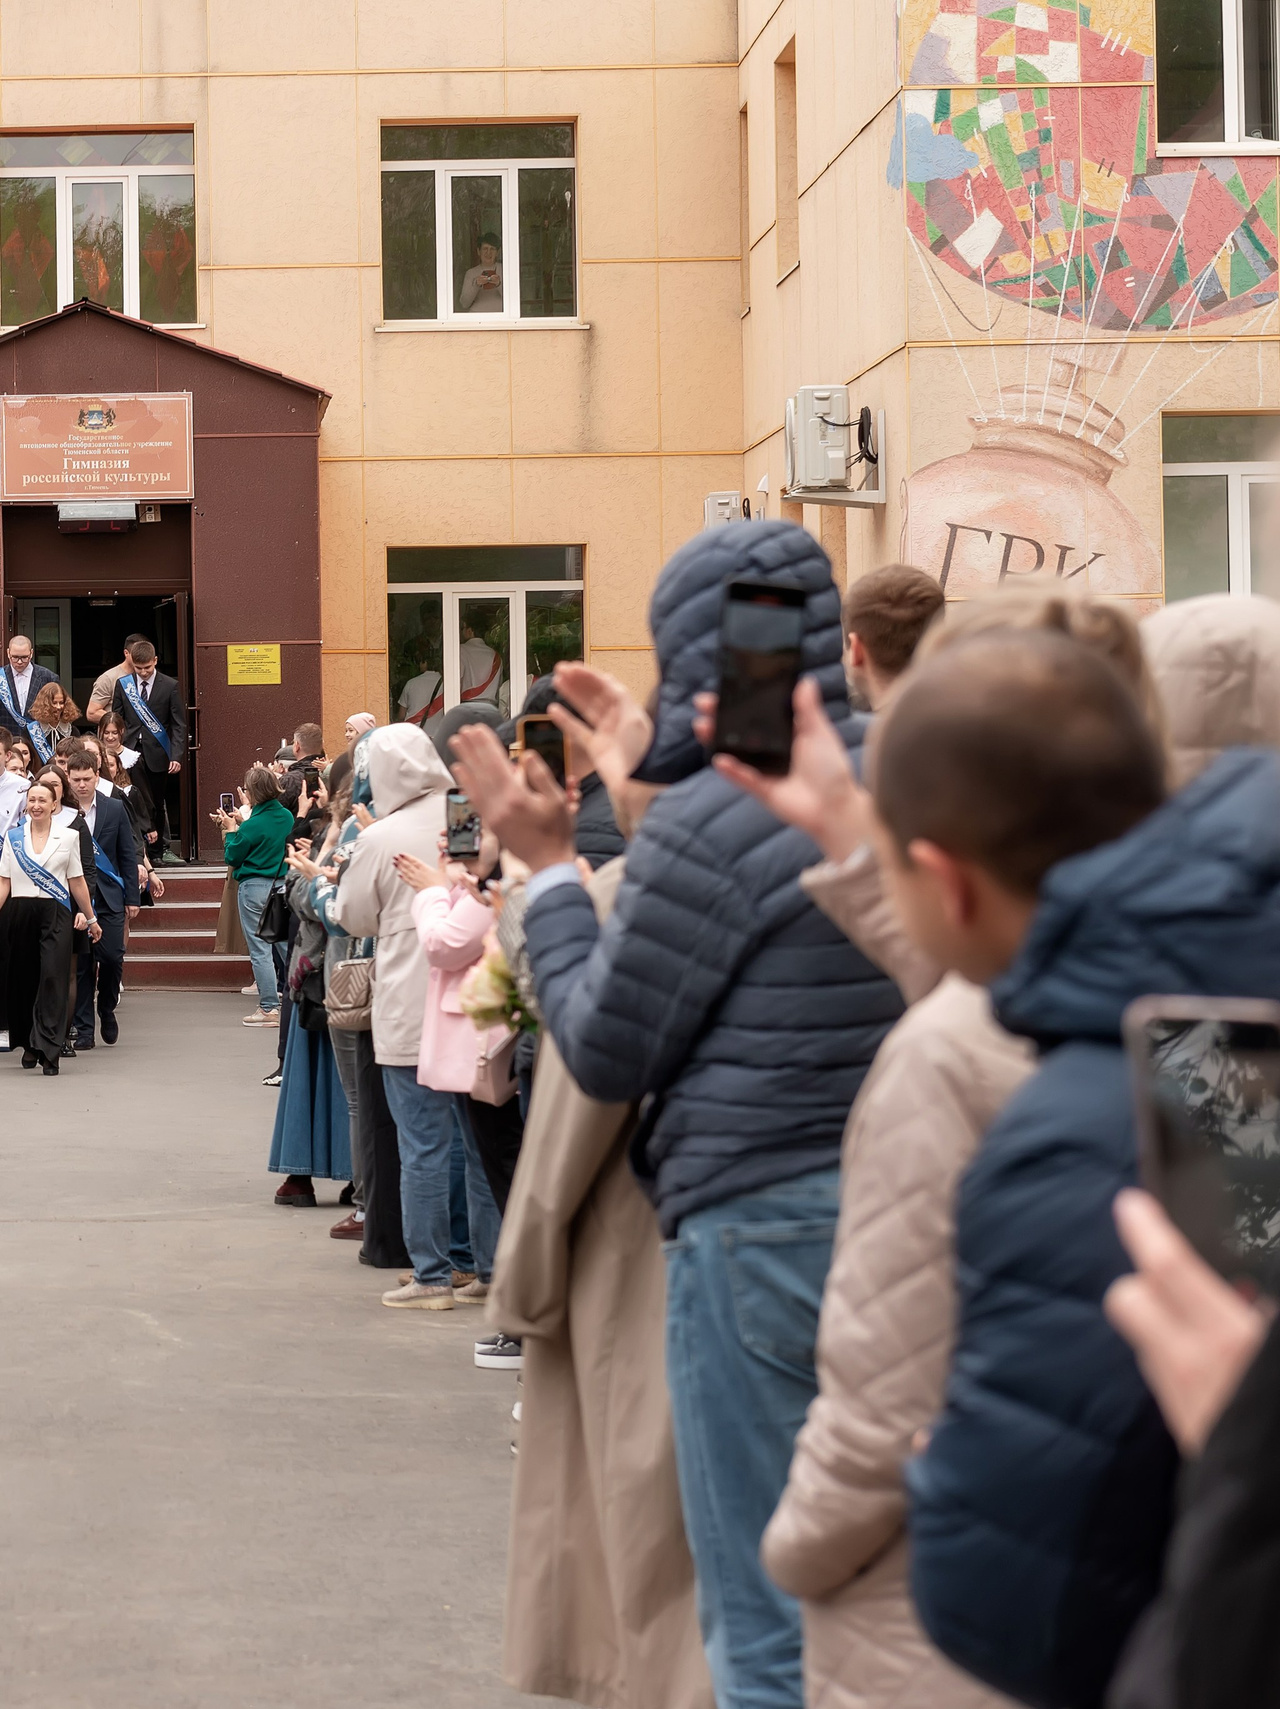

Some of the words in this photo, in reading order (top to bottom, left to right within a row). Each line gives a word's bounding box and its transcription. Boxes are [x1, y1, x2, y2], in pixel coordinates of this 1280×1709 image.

[63, 457, 130, 470] Гимназия
[22, 470, 101, 486] российской
[104, 471, 171, 485] культуры
